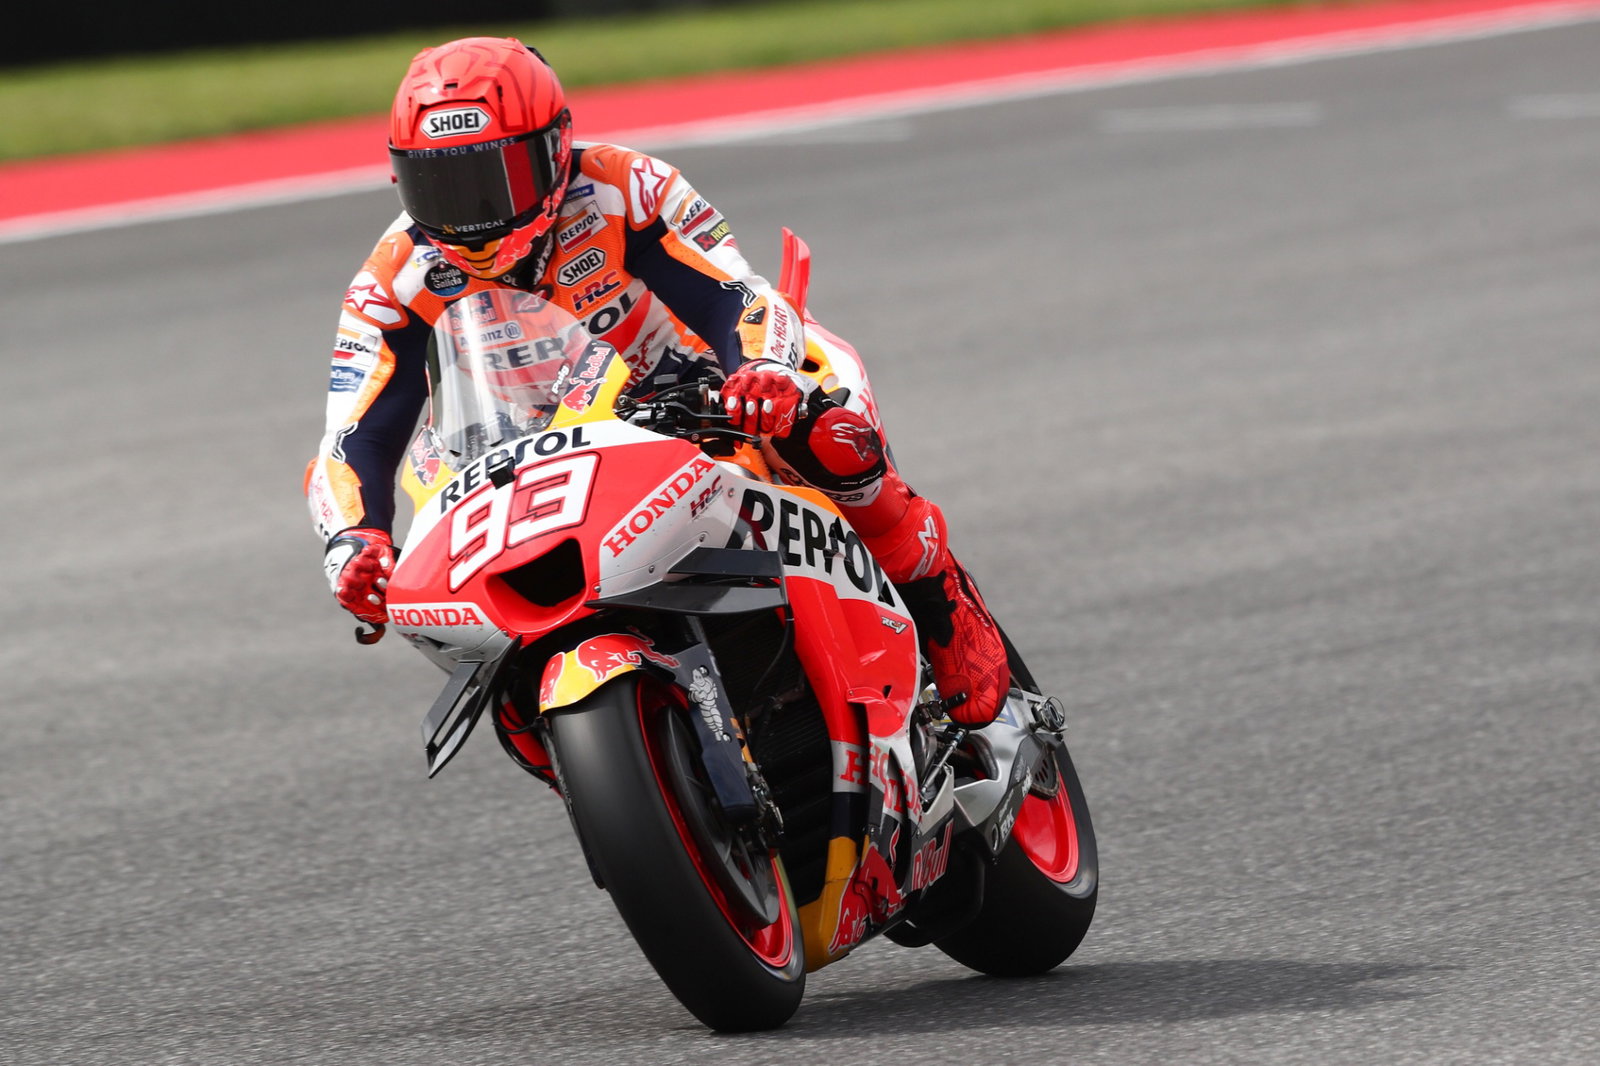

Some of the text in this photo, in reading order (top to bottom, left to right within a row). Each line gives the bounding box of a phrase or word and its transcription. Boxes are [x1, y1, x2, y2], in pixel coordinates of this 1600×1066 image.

[430, 112, 480, 134] SHOEI
[407, 136, 517, 159] GIVES YOU WINGS
[453, 218, 506, 234] VERTICAL
[558, 211, 600, 246] REPSOL
[430, 268, 462, 281] Estrella
[562, 250, 601, 283] SHOEI
[769, 304, 790, 359] One HEART
[551, 364, 571, 396] Puig
[450, 451, 602, 594] 93
[602, 456, 716, 558] HONDA
[388, 607, 484, 627] HONDA
